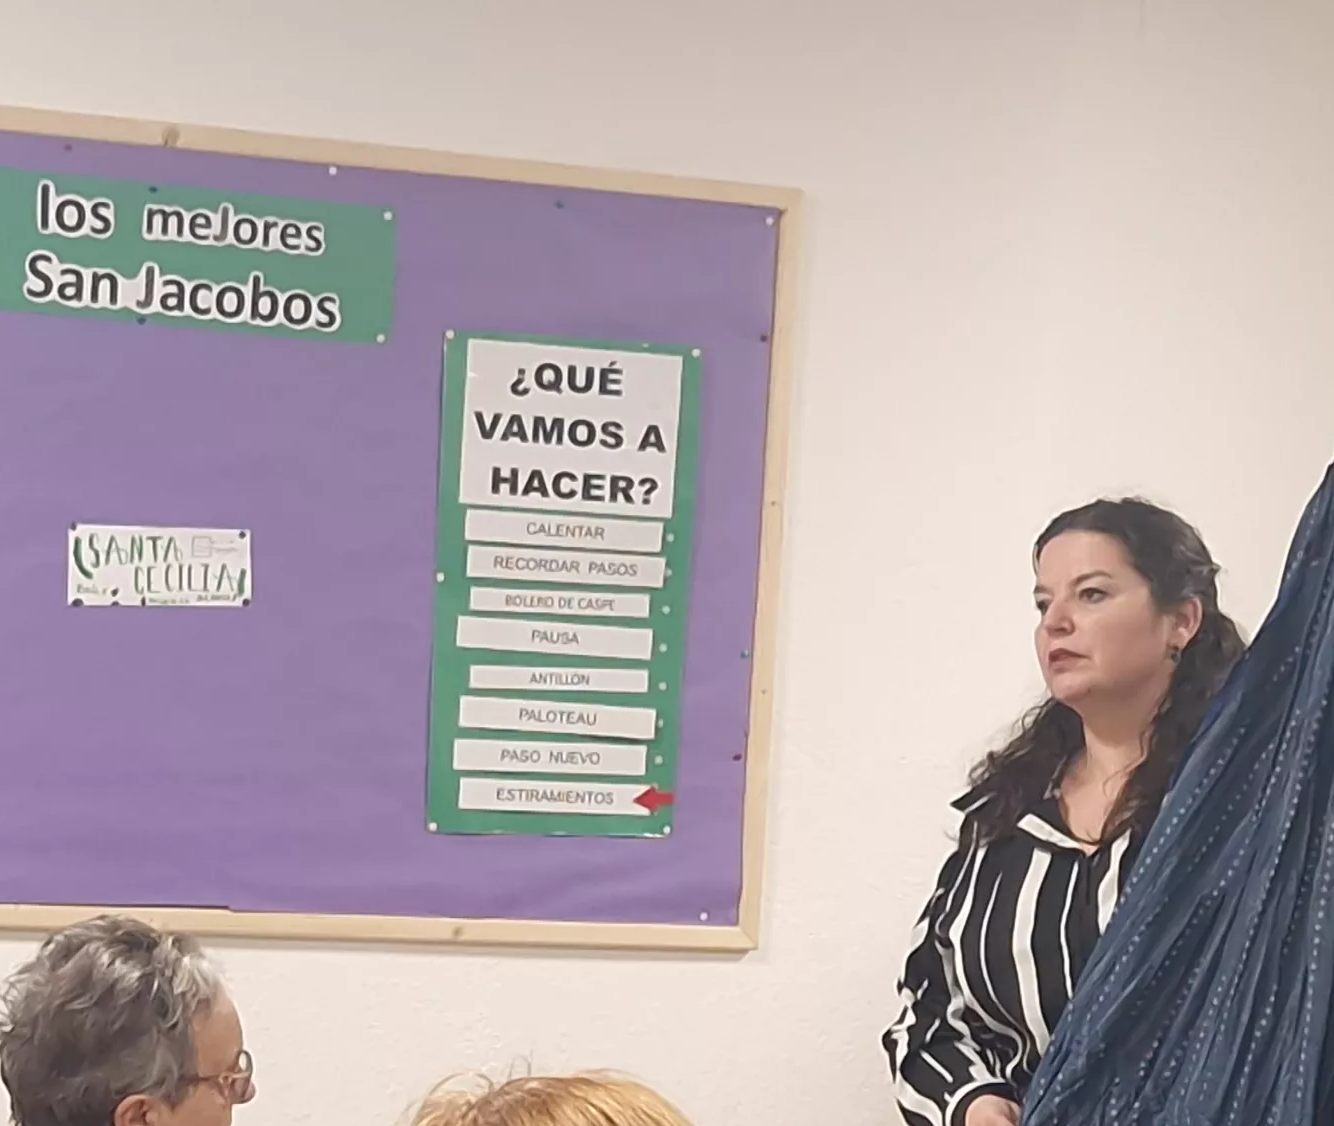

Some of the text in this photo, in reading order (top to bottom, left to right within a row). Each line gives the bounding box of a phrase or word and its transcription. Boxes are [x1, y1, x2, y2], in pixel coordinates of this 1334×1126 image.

[39, 182, 113, 236] los
[27, 254, 340, 328] San Jacobos
[510, 360, 623, 396] ¿QUÉ
[474, 411, 666, 453] VAMOS A
[491, 466, 658, 505] HACER?
[526, 522, 605, 540] CALENTAR
[493, 555, 638, 577] RECORDAR PASOS
[505, 594, 554, 608] BOLERO
[558, 597, 573, 609] DE
[532, 629, 579, 645] PAUSA
[519, 708, 597, 726] PALOTEAU
[501, 749, 600, 765] PASO NUEVO
[496, 787, 614, 805] ESTIRAMIENTOS
